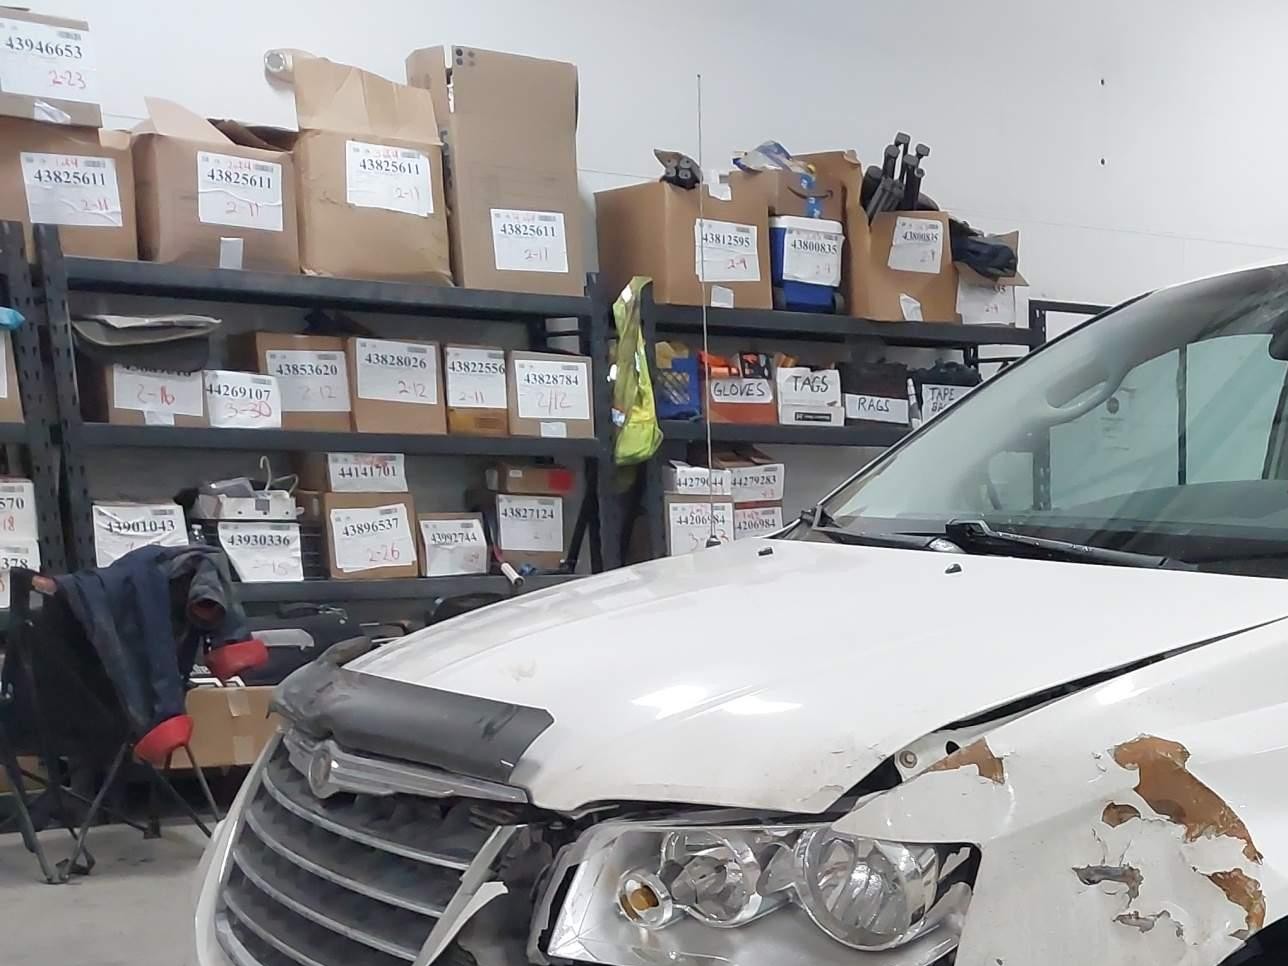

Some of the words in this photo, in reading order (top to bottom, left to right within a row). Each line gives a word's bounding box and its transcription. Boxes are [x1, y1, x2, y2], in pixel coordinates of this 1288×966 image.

[6, 36, 83, 59] 43946653
[48, 70, 87, 90] 2-23
[359, 158, 420, 175] 43825611
[34, 169, 105, 186] 43825611
[207, 168, 271, 189] 43825611
[500, 223, 556, 237] 43825611
[702, 232, 752, 248] 43812595
[791, 239, 838, 255] 43800835
[364, 352, 428, 370] 43828026
[448, 360, 505, 375] 43822556
[276, 364, 338, 377] 43853620
[523, 373, 579, 387] 43828784
[793, 375, 829, 392] TAGS
[205, 383, 271, 401] 44269107
[713, 382, 765, 397] GLOVES
[929, 387, 955, 401] TAPE
[857, 397, 890, 412] RAGS
[339, 465, 398, 478] 44141701
[731, 474, 777, 487] 44279283
[501, 507, 555, 519] 43827124
[107, 519, 175, 534] 43901043
[342, 518, 399, 537] 43896537
[227, 534, 291, 547] 43930336
